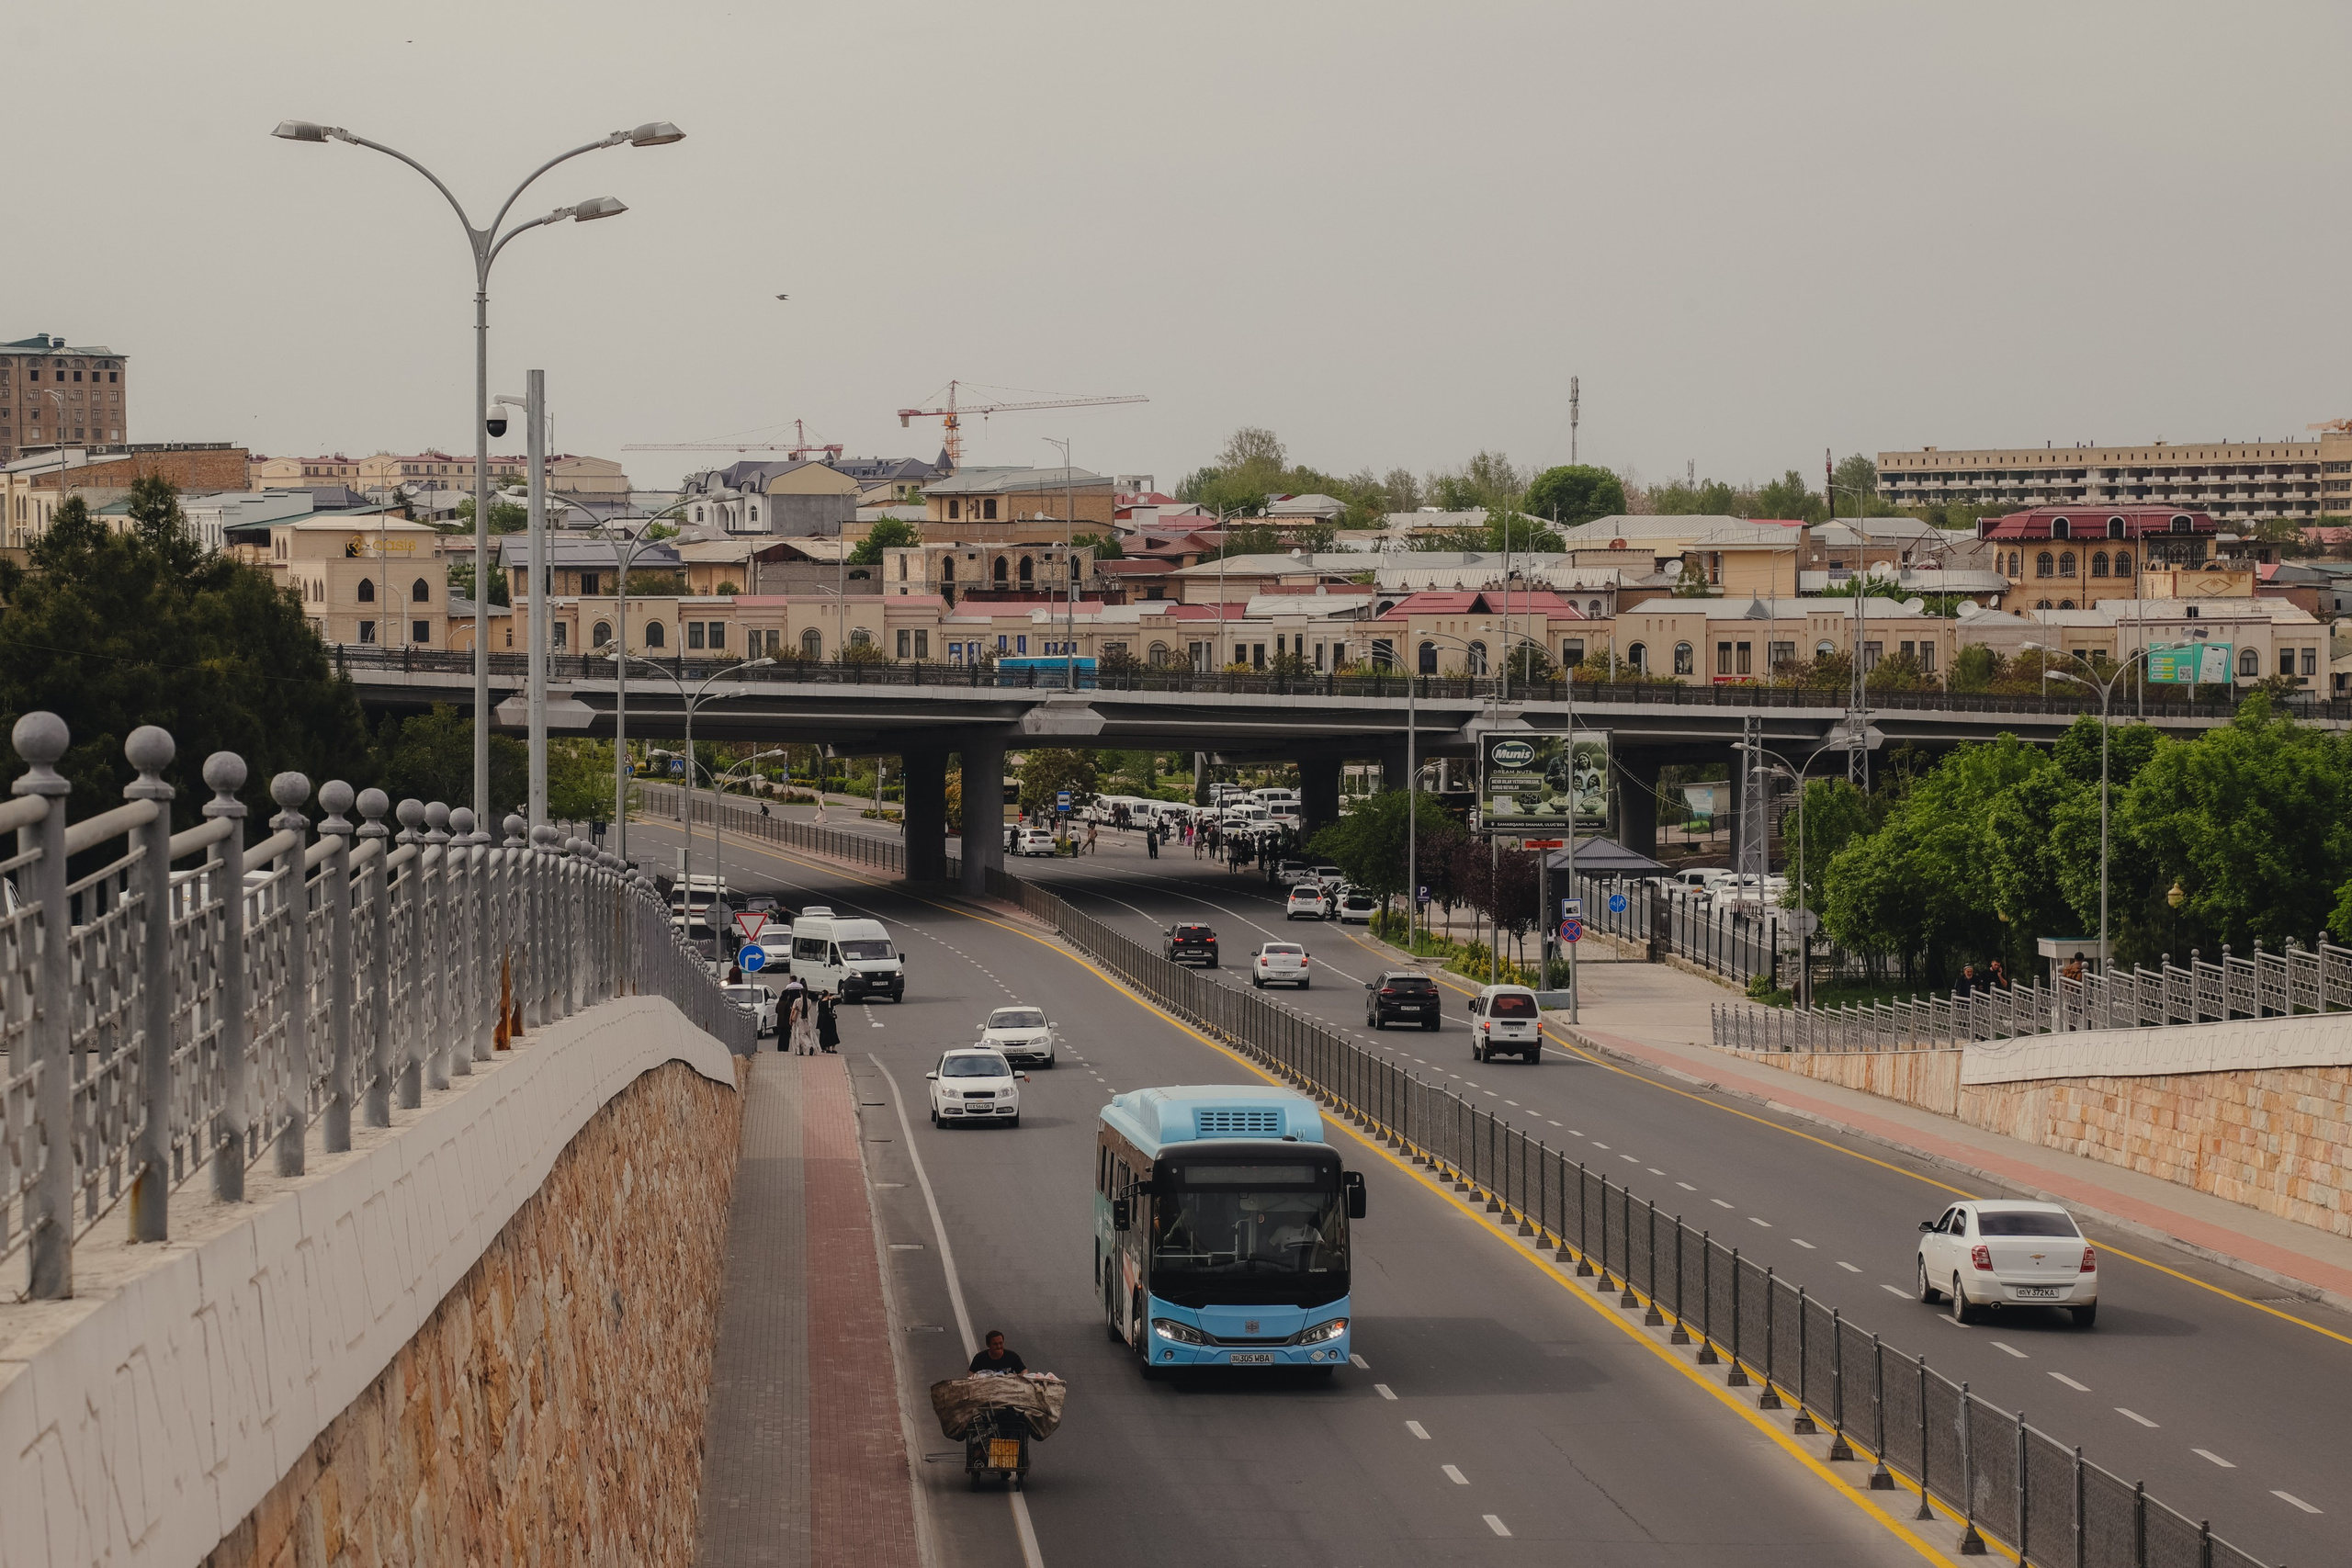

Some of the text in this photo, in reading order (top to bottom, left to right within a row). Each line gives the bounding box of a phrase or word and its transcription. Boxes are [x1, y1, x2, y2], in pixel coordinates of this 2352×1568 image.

[373, 539, 416, 550] oasis
[1495, 749, 1532, 759] Munis
[1420, 886, 1427, 896] P
